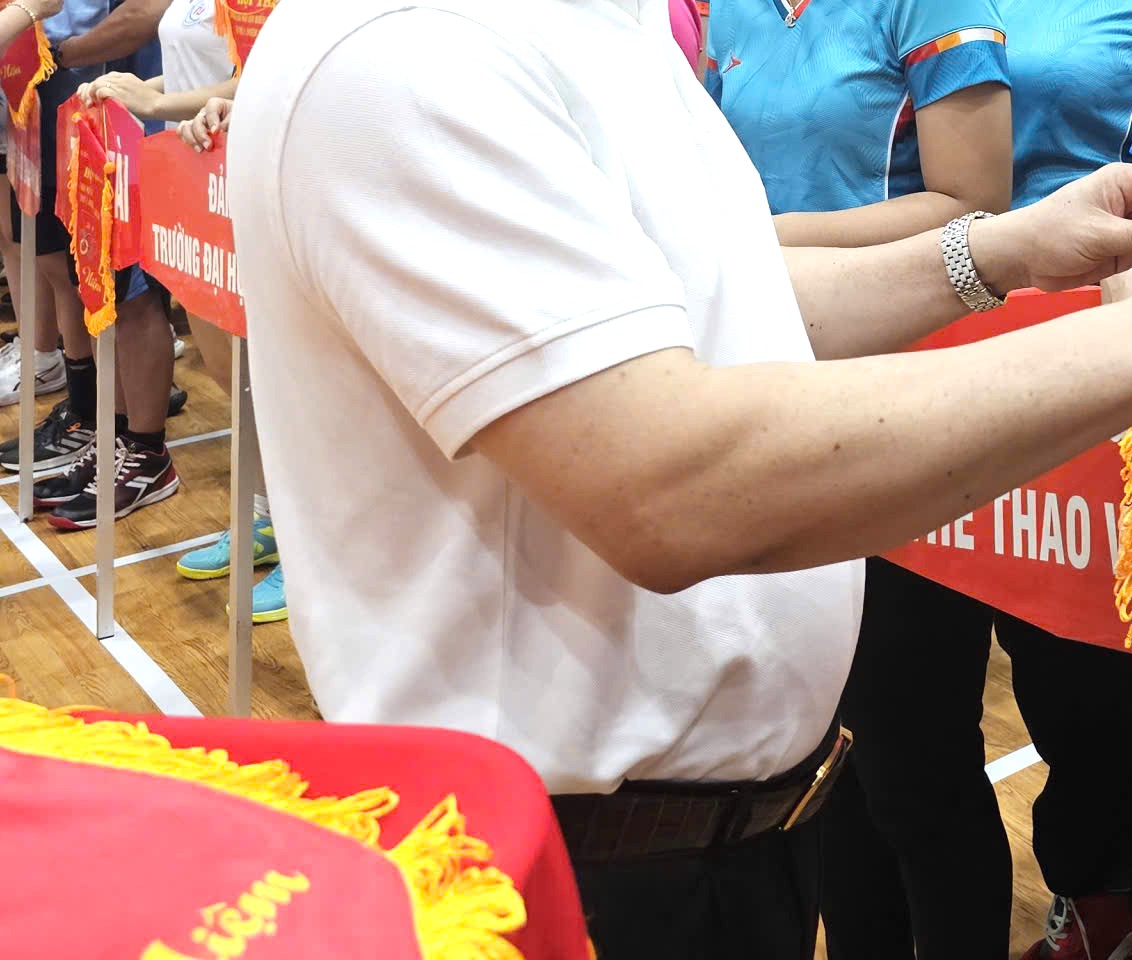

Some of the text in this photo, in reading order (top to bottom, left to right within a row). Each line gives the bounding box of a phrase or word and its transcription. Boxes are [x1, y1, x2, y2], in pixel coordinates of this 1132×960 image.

[208, 163, 231, 219] ĐẢN
[152, 222, 200, 279] TRƯỜNG
[203, 241, 224, 296] ĐẠI
[993, 487, 1091, 570] THAO
